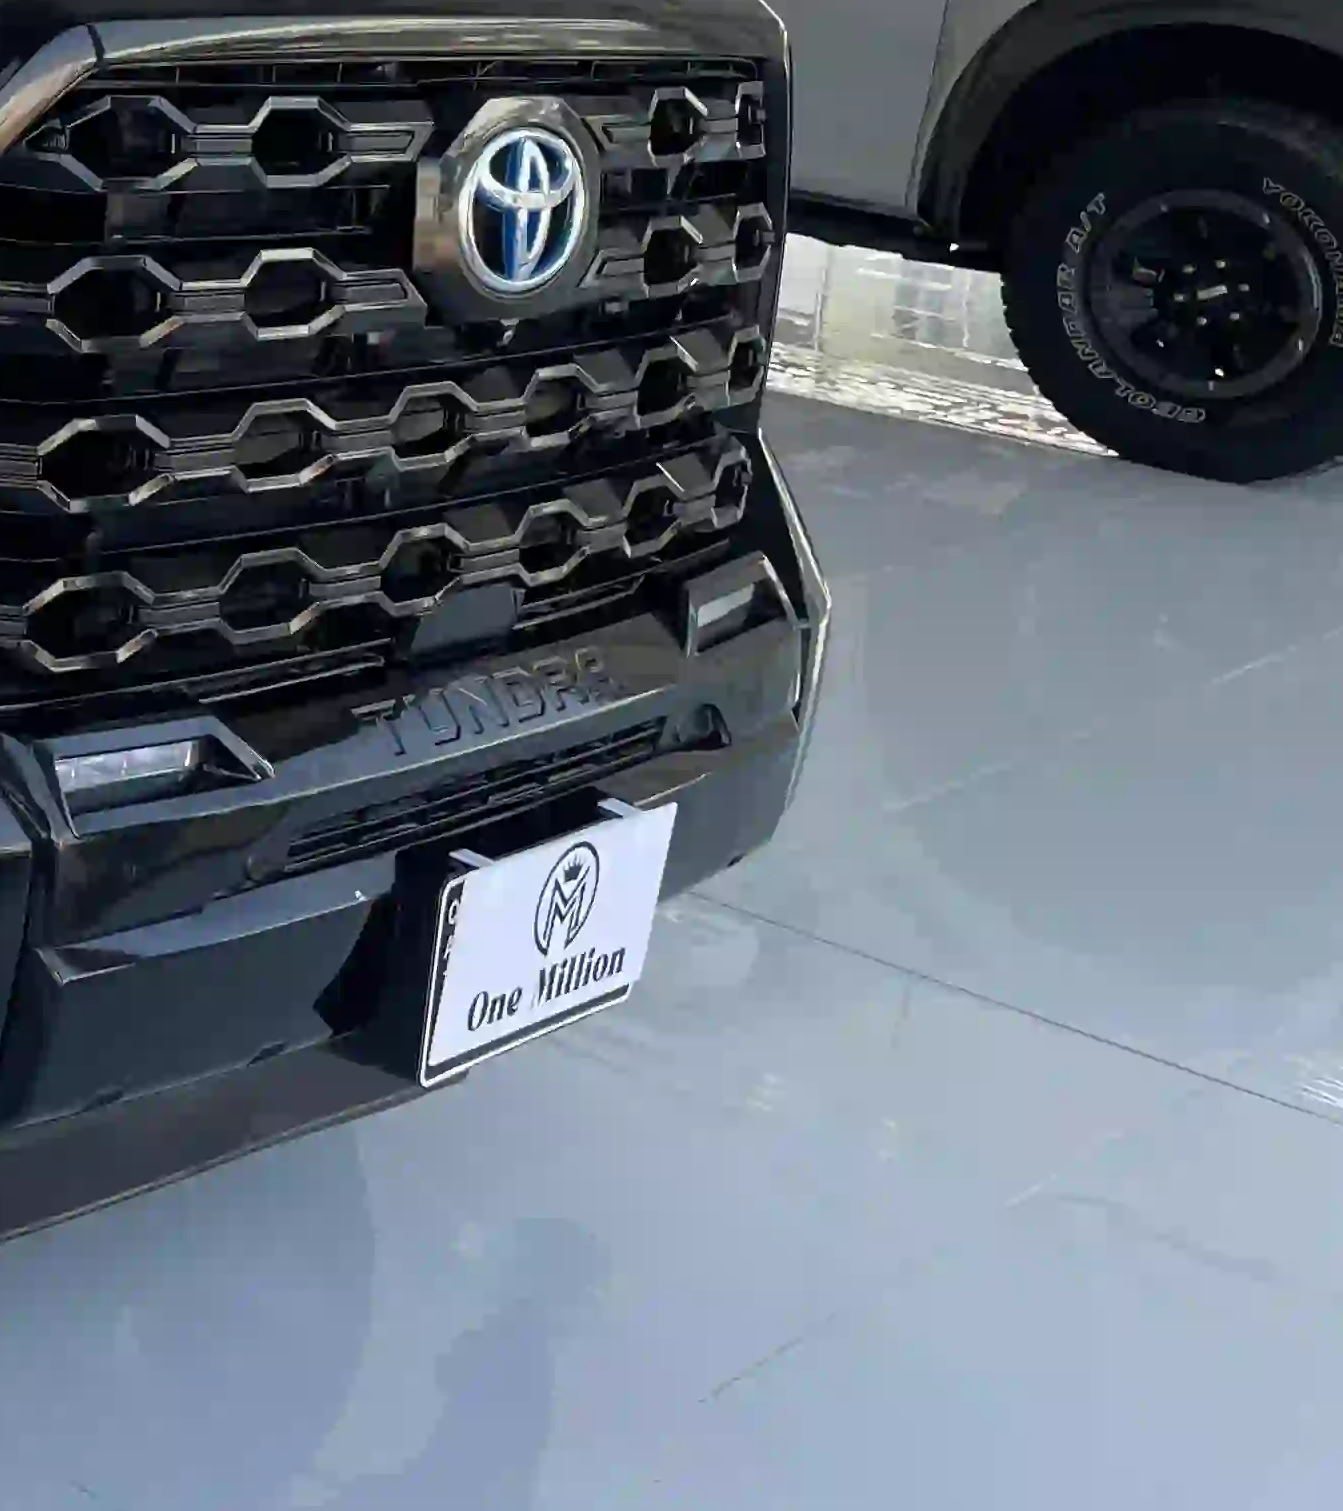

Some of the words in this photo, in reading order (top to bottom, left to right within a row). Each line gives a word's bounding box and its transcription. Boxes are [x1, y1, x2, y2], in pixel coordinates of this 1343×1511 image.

[350, 646, 623, 757] TUNDRA
[467, 986, 523, 1032] One
[530, 946, 627, 1011] Million
